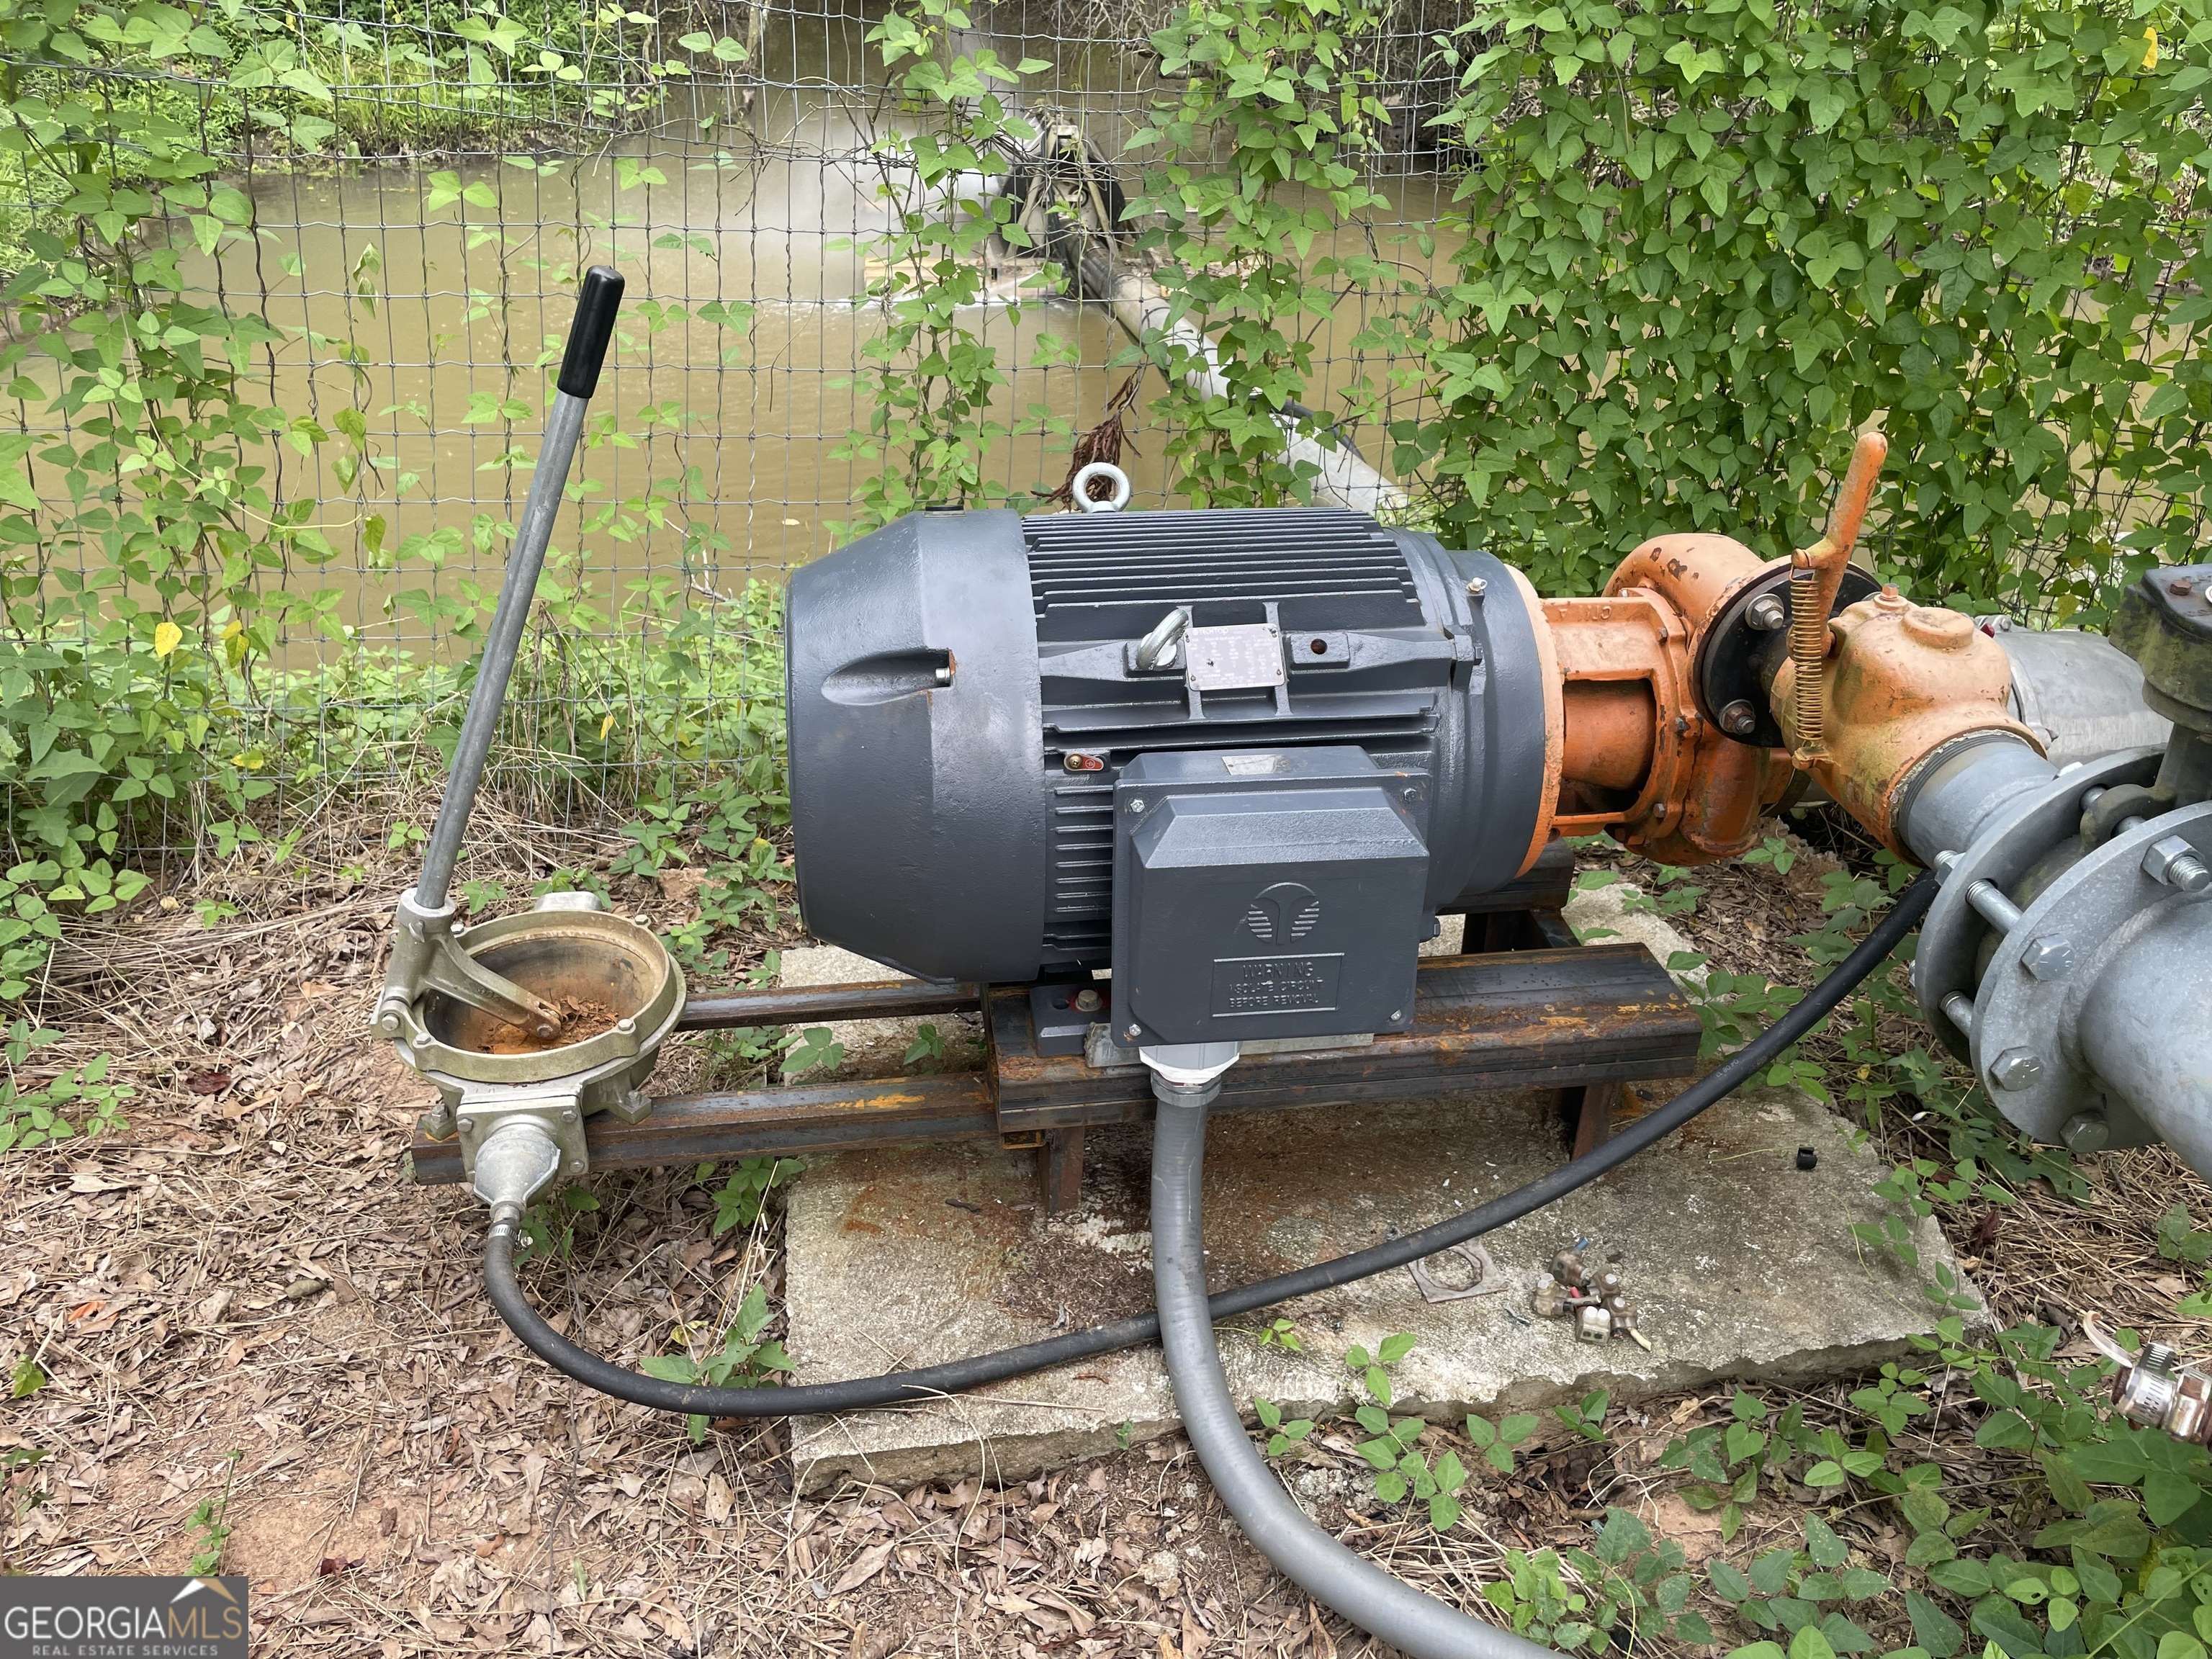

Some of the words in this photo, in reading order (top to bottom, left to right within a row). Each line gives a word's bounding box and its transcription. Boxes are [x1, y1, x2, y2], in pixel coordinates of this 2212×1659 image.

[1243, 962, 1313, 979] WARNING
[1229, 980, 1274, 994] ISOLATE
[1281, 977, 1323, 991] CIRCUIT
[1229, 996, 1268, 1007] BEFORE
[1274, 994, 1319, 1005] REMOVAL
